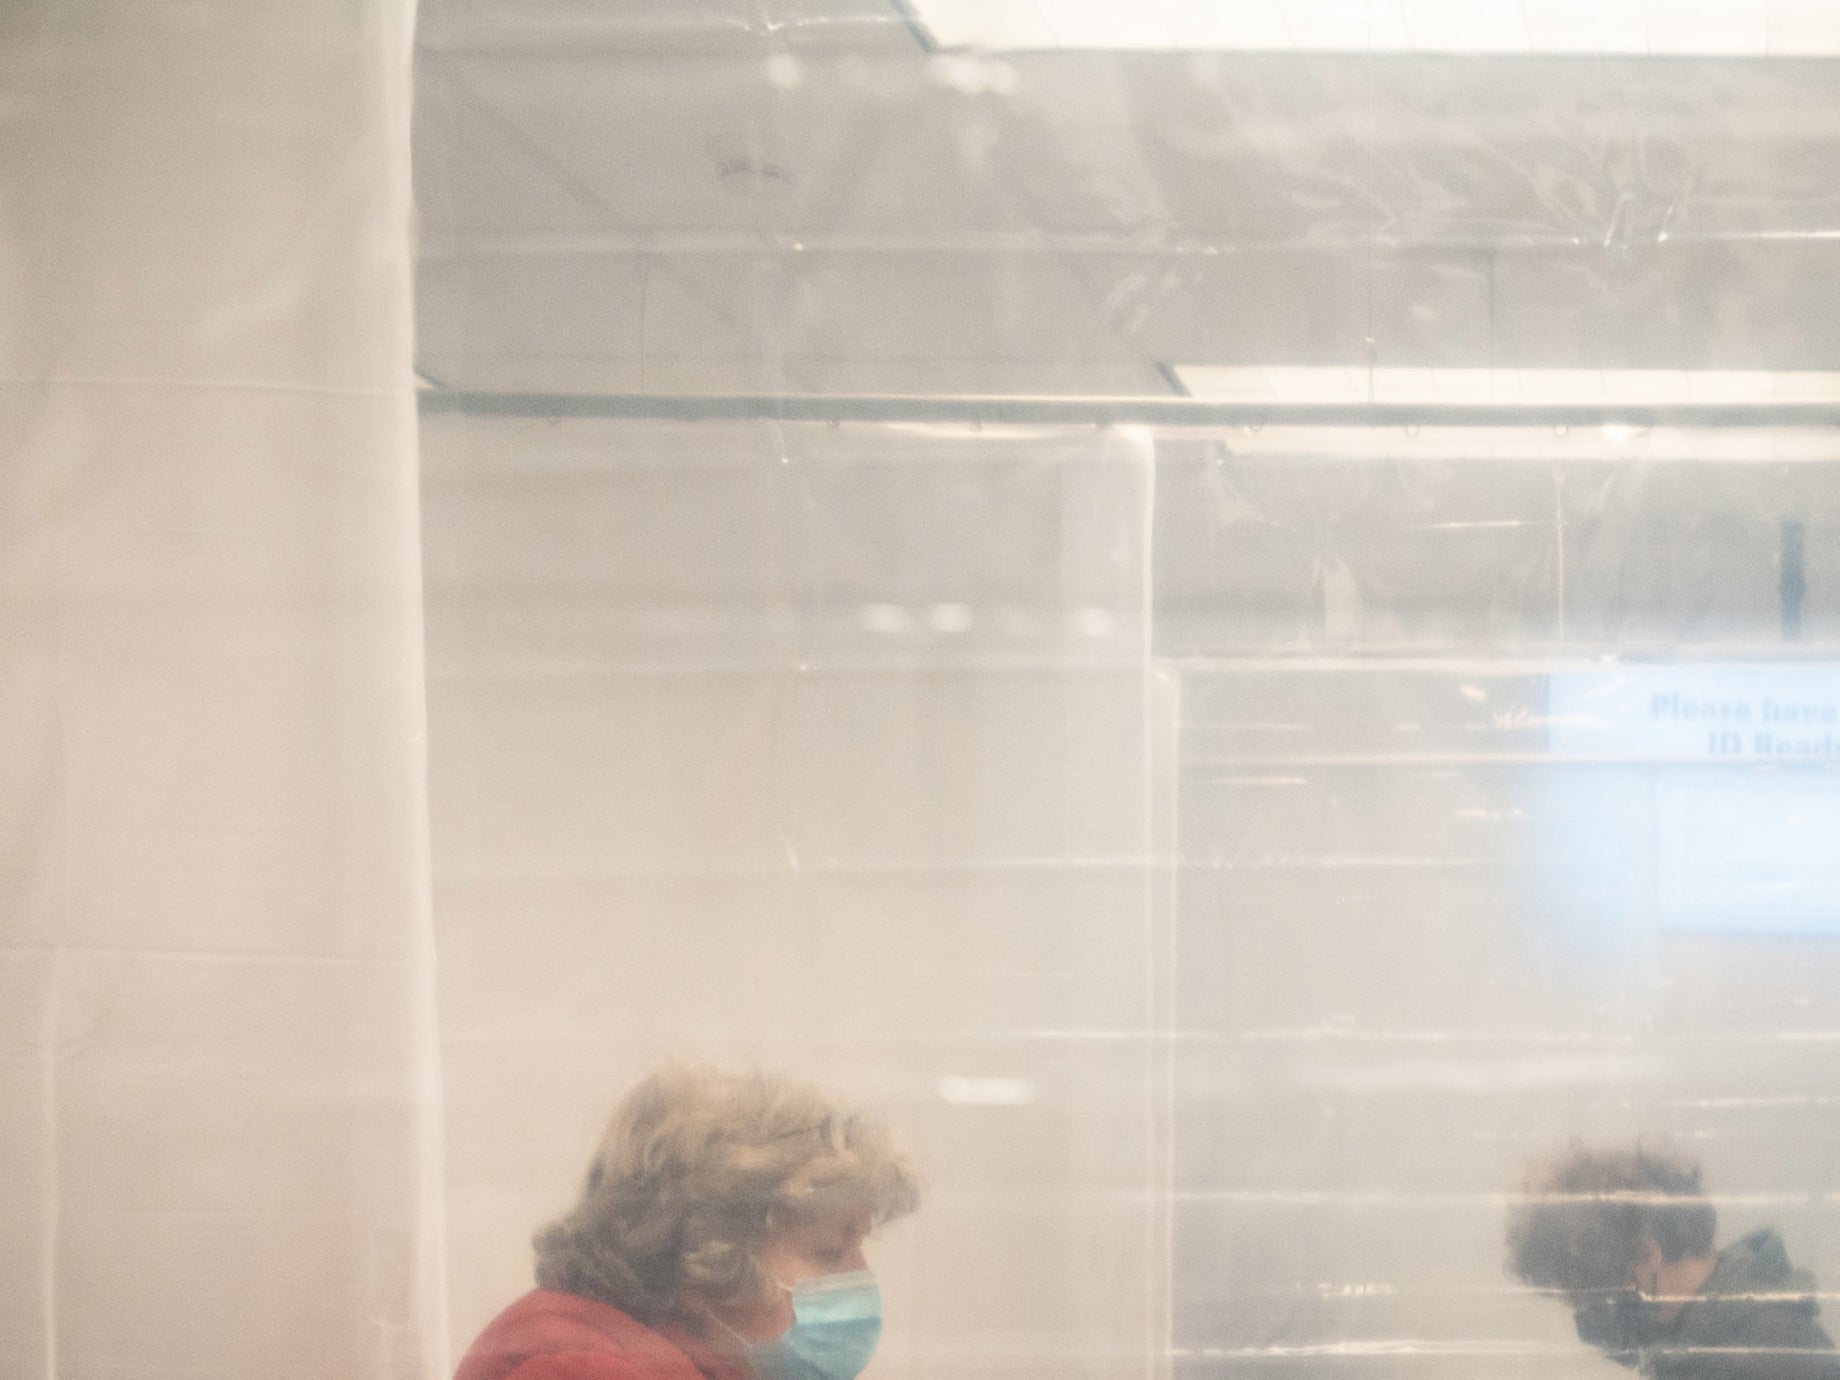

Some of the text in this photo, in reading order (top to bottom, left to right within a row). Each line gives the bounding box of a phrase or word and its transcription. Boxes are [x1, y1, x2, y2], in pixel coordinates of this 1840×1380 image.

[1650, 692, 1751, 723] Please
[1762, 693, 1838, 726] have
[1708, 731, 1742, 756] ID
